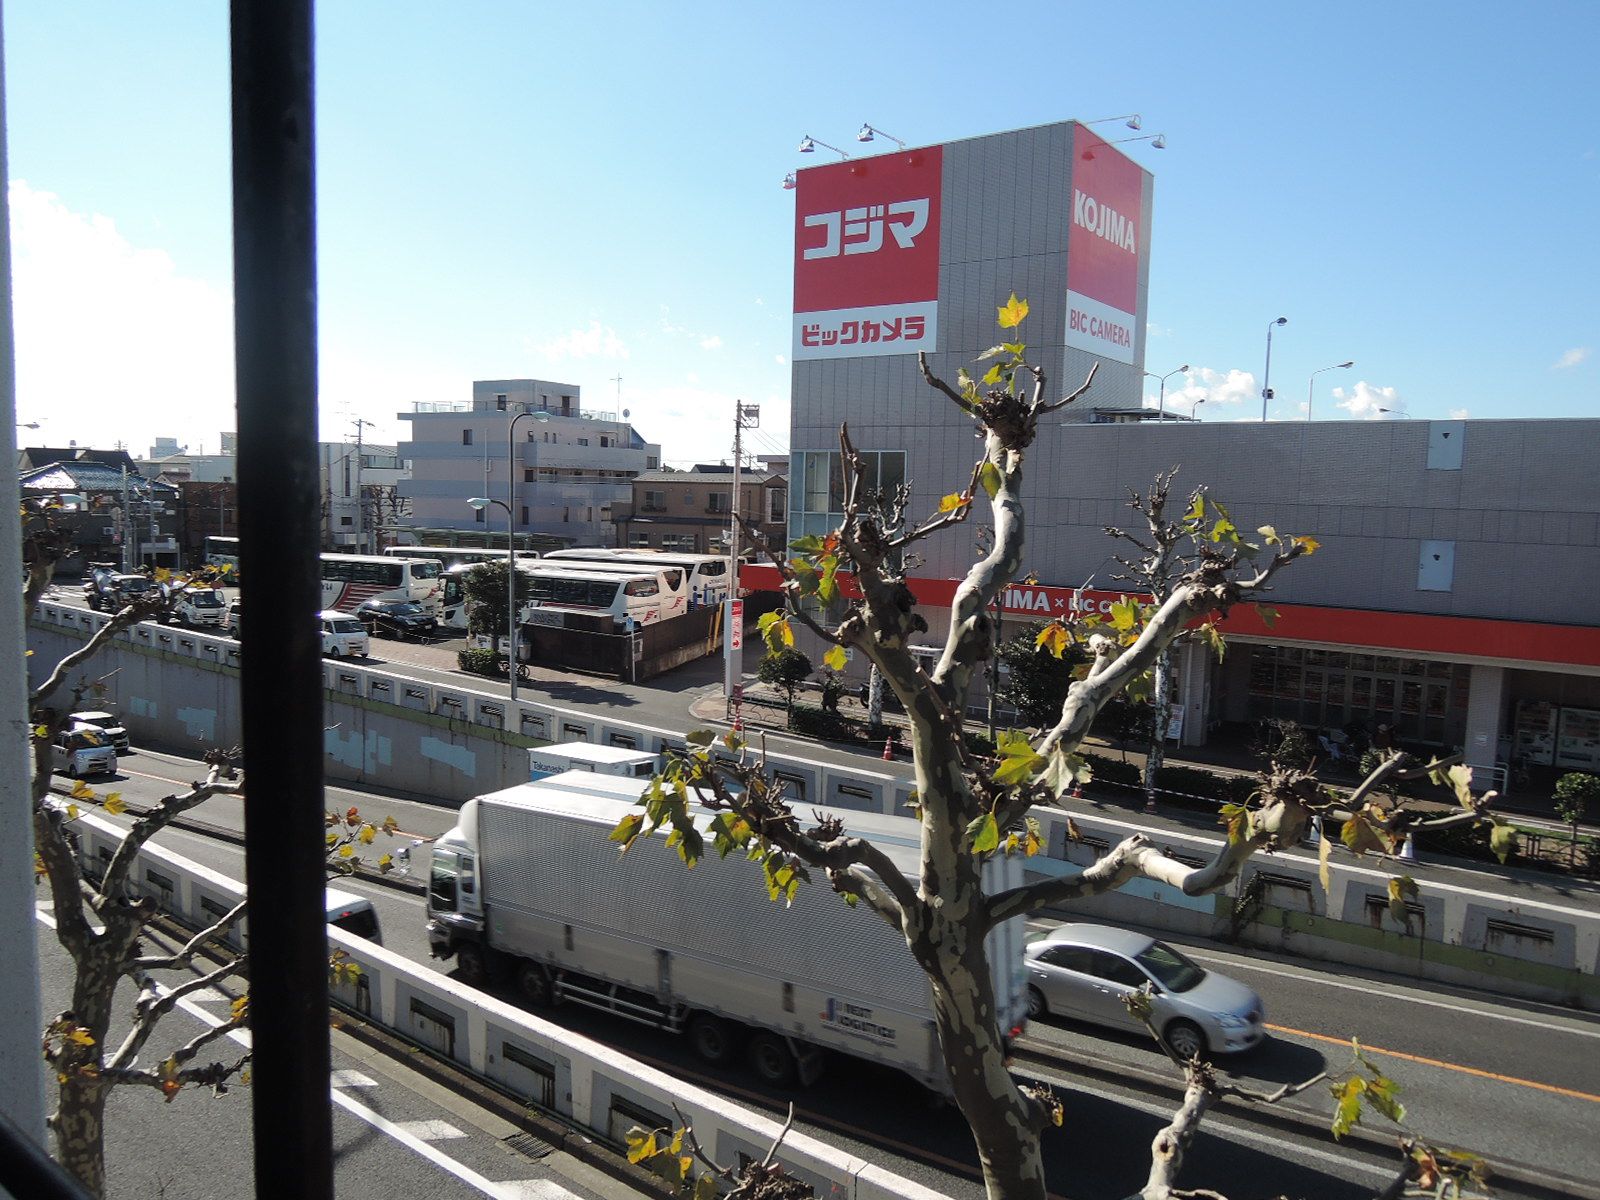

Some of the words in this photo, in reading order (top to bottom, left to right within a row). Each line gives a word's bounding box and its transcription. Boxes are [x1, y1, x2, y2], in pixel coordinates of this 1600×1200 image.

[803, 198, 930, 261] コジマ
[1073, 189, 1136, 254] KOJIMA
[802, 316, 926, 347] ビックカメラ
[1069, 308, 1088, 334] BIC
[1089, 316, 1131, 348] CAMERA
